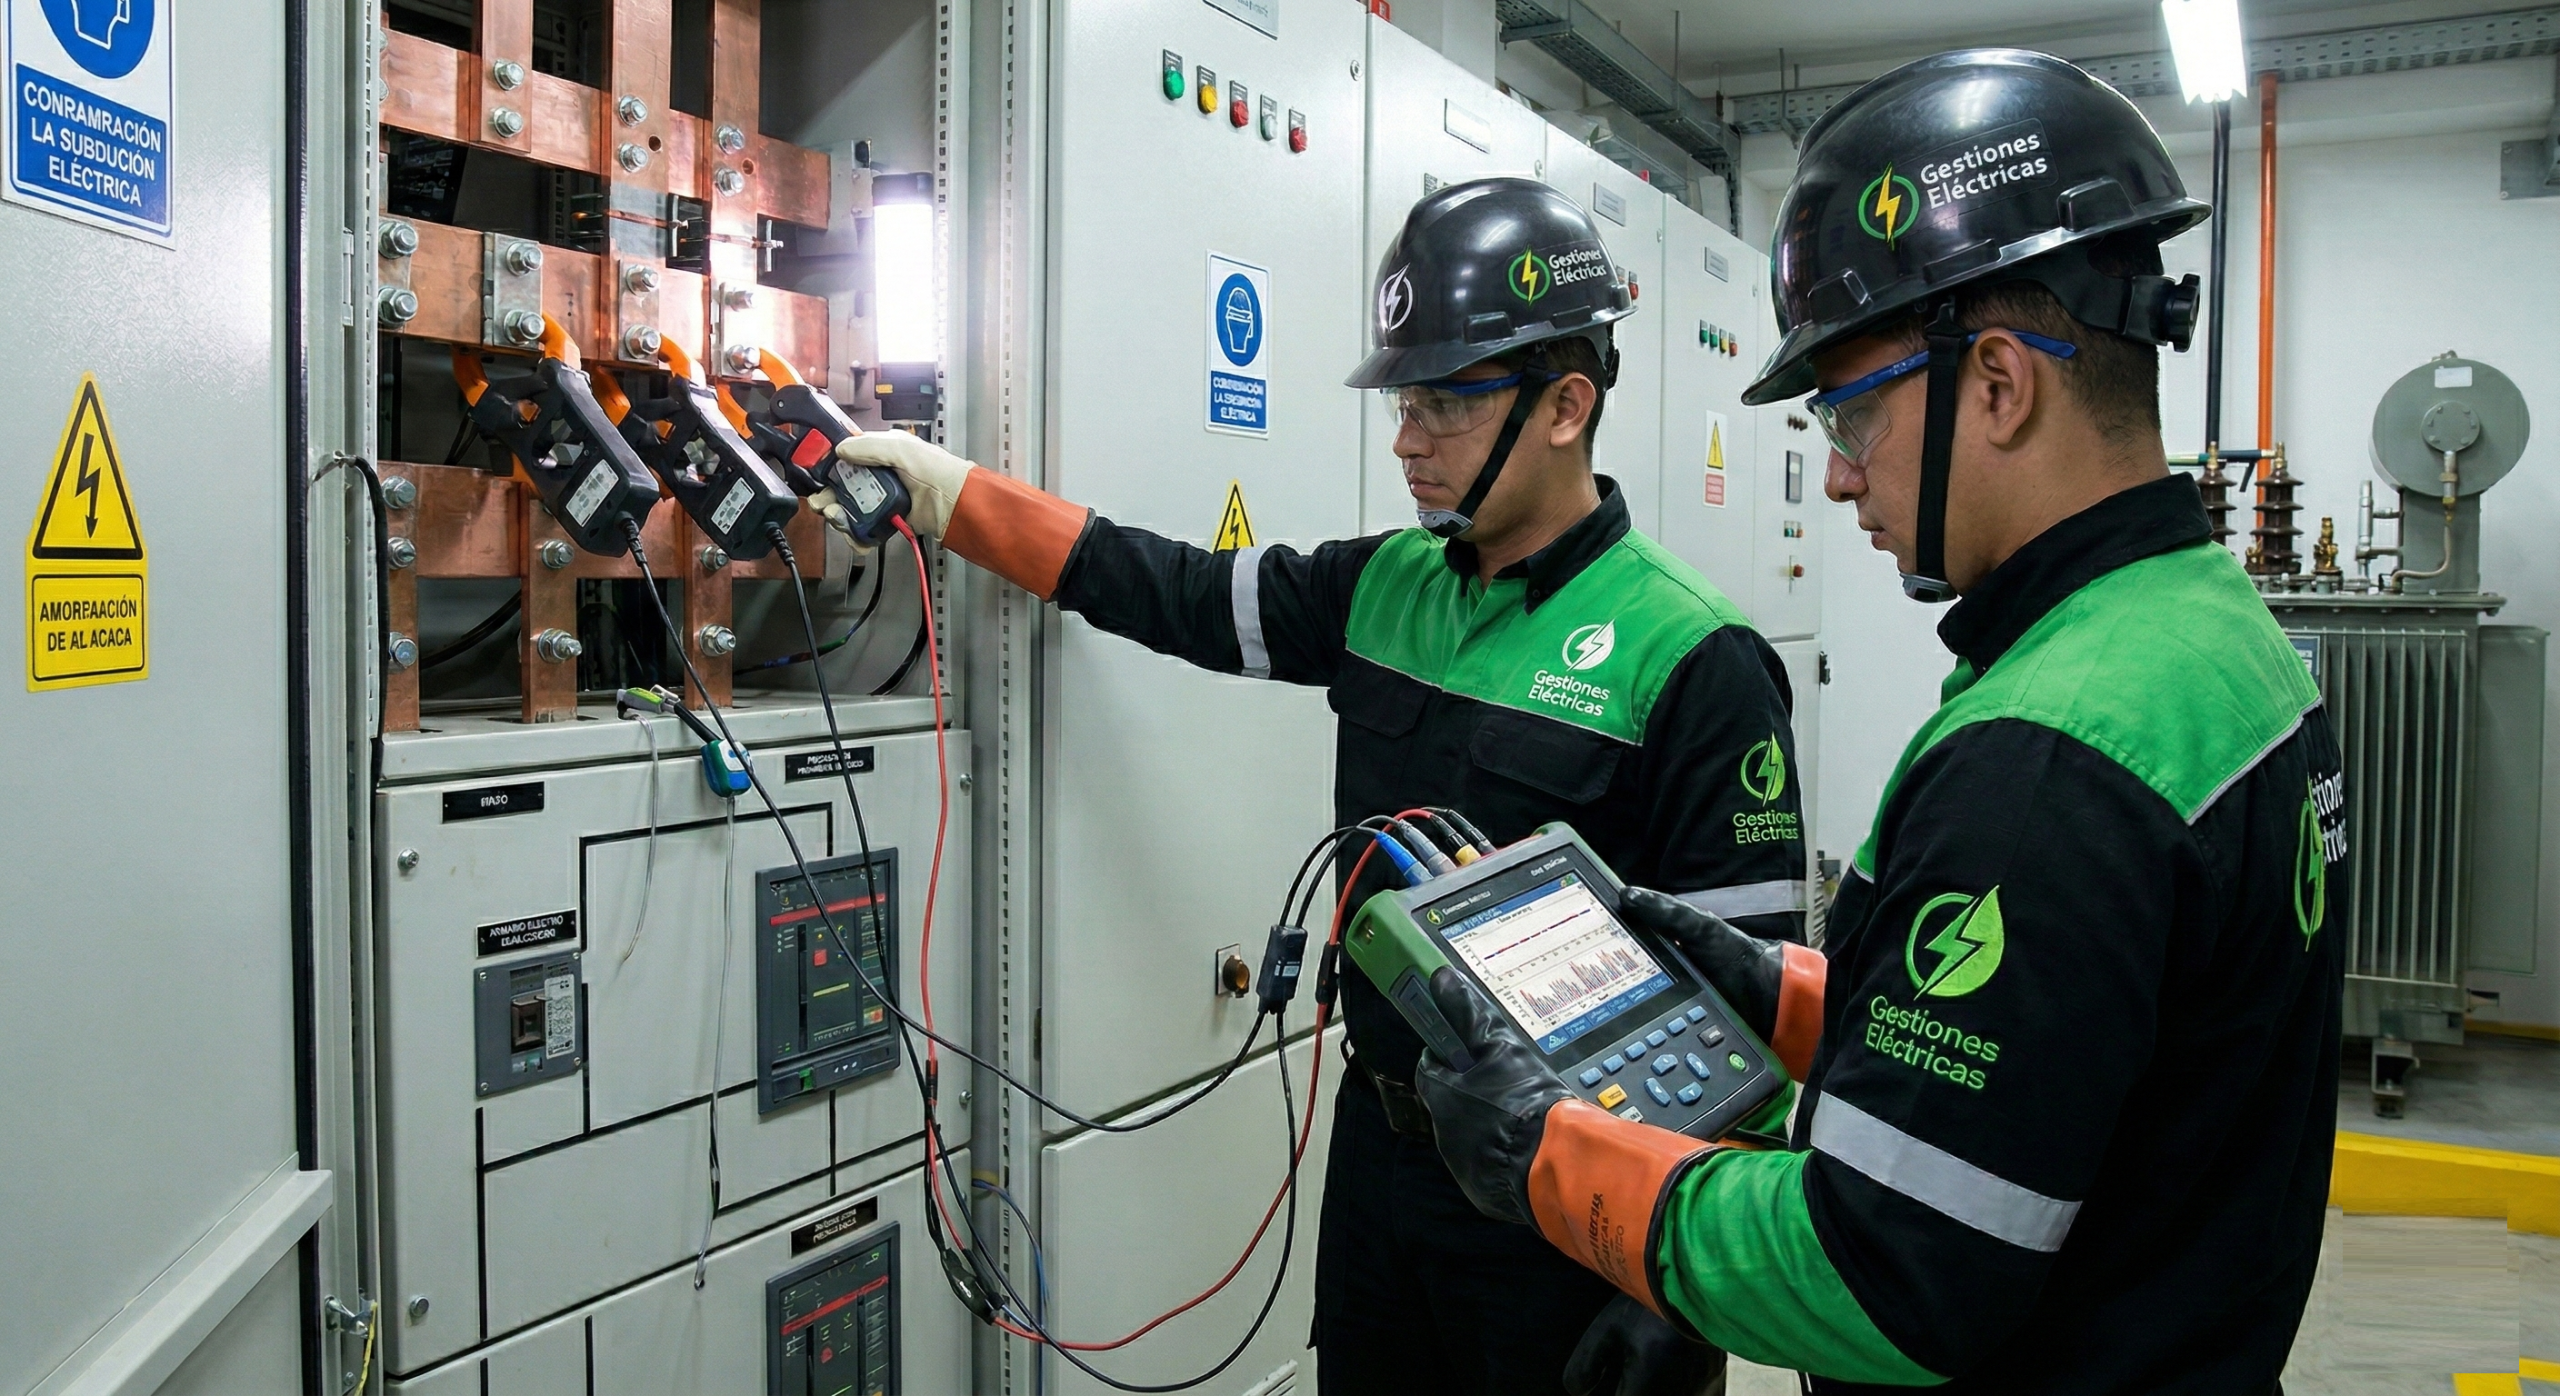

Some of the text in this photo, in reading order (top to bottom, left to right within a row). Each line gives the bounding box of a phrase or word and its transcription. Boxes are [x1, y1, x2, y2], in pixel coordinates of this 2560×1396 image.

[24, 81, 161, 153] CONRAMRACIÓN
[31, 117, 155, 181] LA SUBDUCIÓN
[1920, 133, 2041, 185] Gestiones
[49, 156, 142, 207] ELÉCTRICA
[1926, 157, 2048, 209] Eléctricas
[48, 632, 66, 652] DE
[1528, 684, 1604, 716] Eléctricas
[1534, 669, 1611, 700] Gestiones
[1870, 995, 2000, 1062] Gestiones
[1865, 1022, 1986, 1089] Eléctricas
